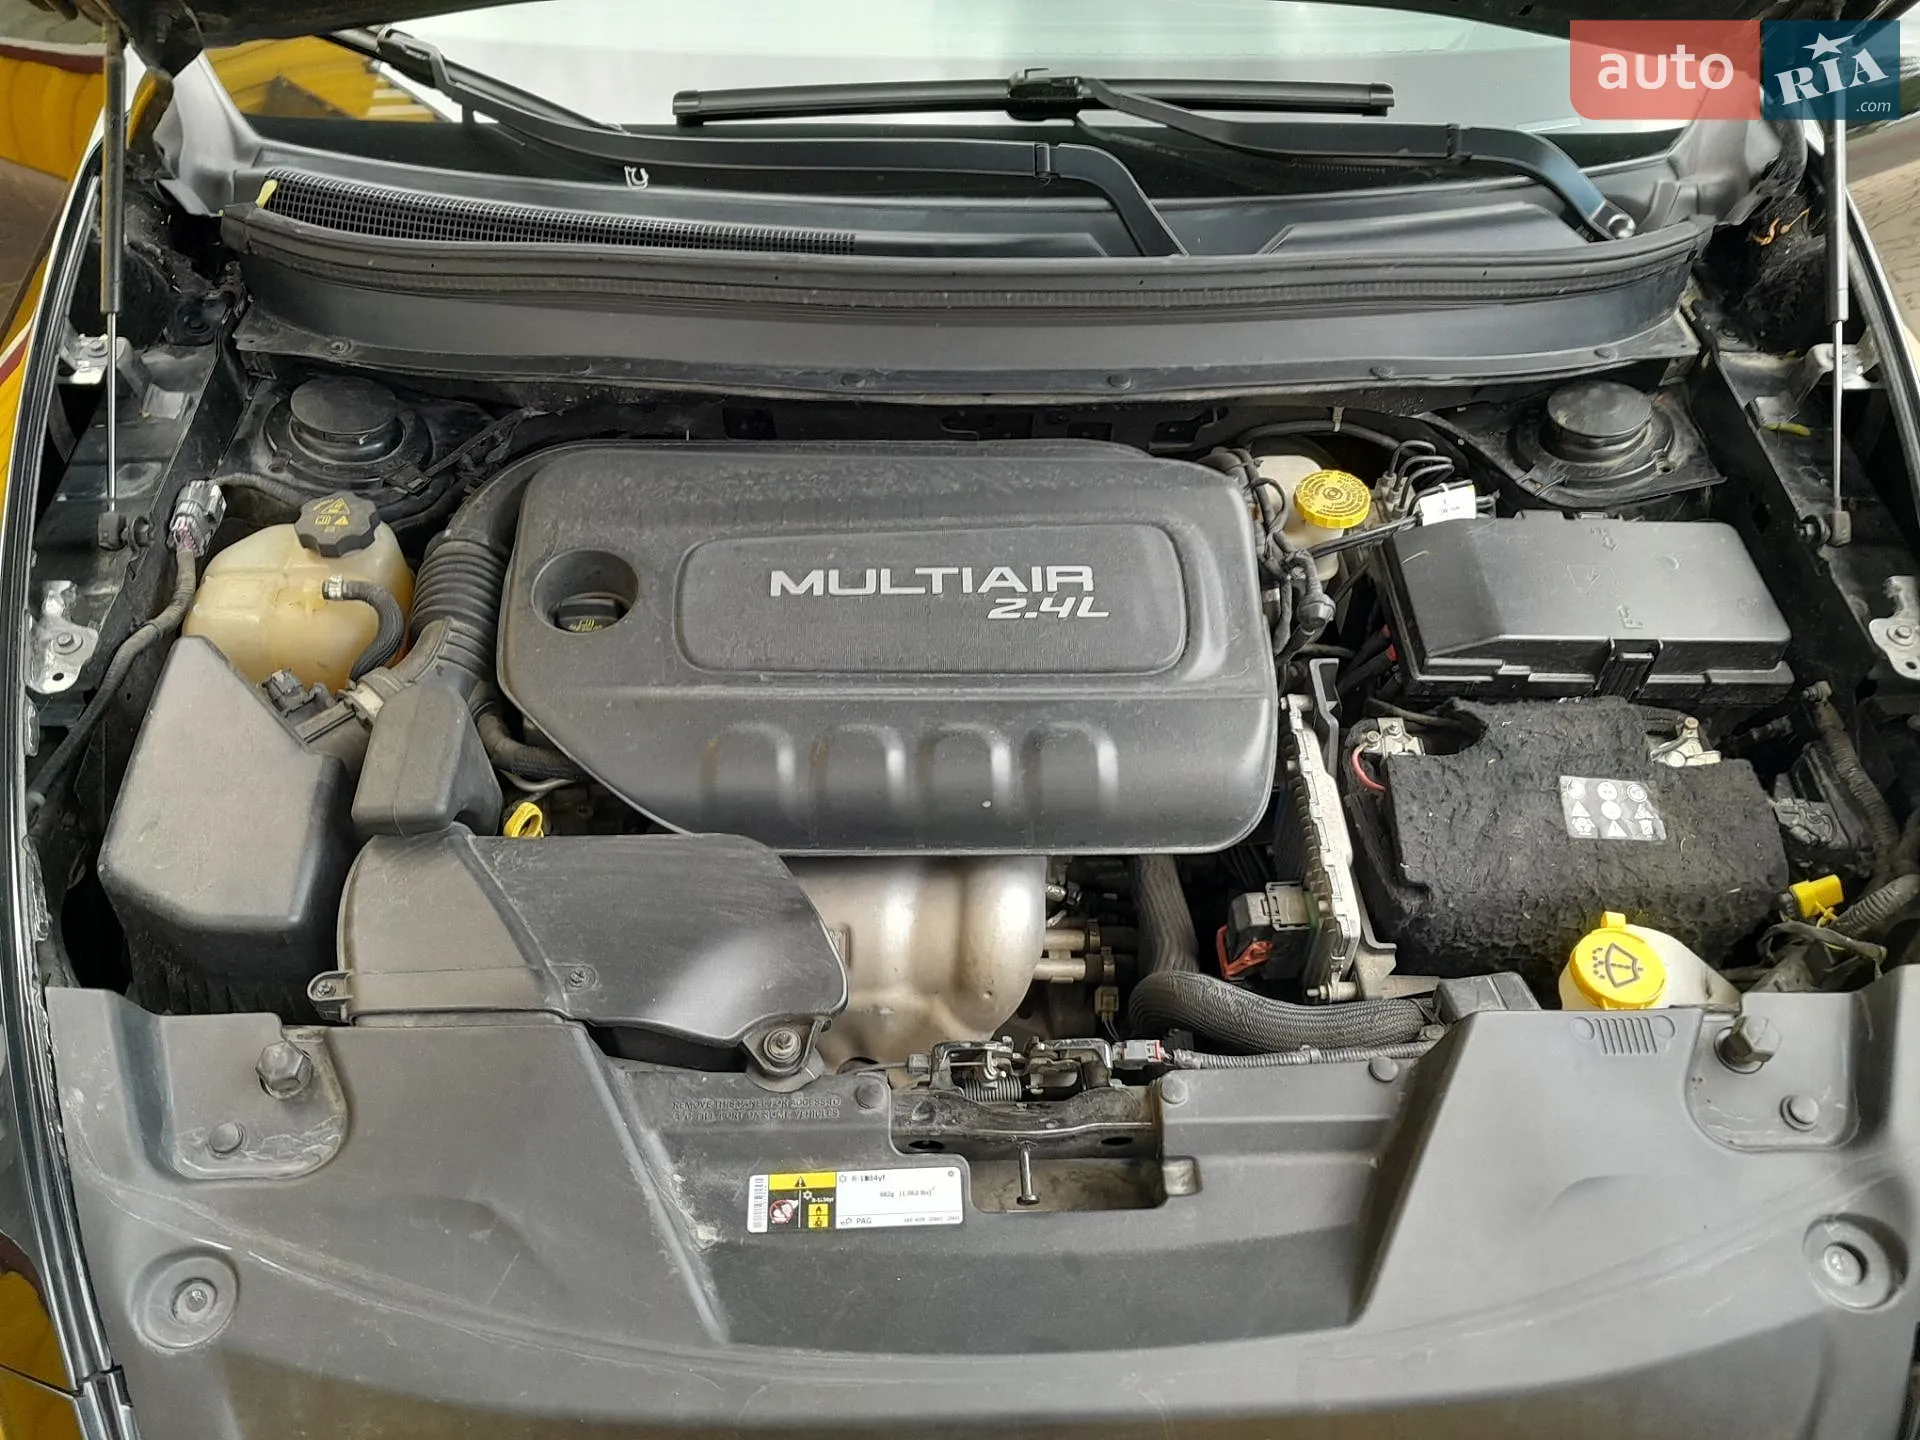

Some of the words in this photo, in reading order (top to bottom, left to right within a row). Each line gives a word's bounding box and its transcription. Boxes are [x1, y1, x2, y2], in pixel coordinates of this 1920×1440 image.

[769, 565, 1095, 597] MULTIAIR
[986, 597, 1110, 619] 2.4L
[856, 1217, 873, 1225] PAG
